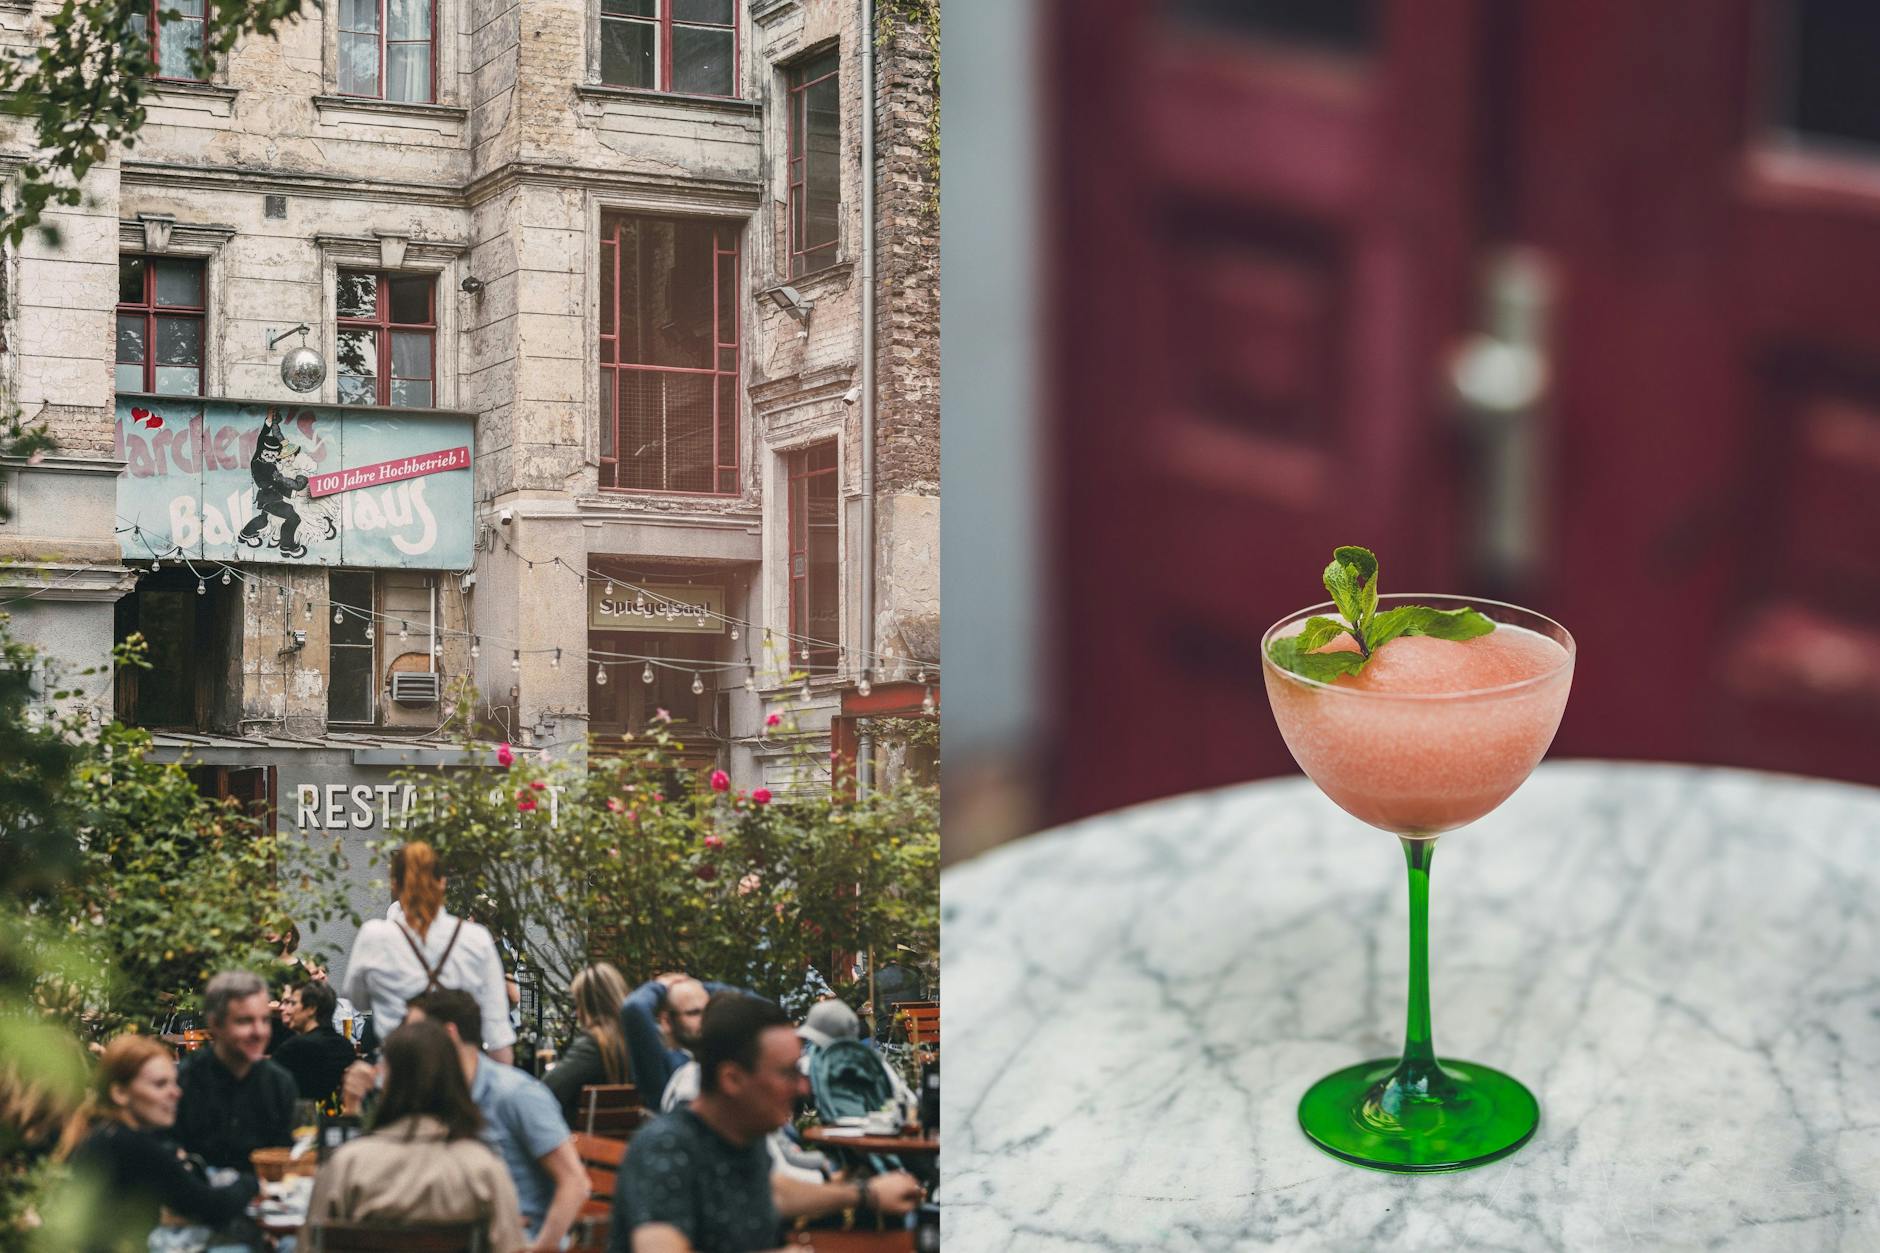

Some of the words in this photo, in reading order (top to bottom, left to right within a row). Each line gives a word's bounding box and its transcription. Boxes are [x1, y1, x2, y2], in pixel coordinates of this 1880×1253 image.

[316, 476, 339, 492] 100
[341, 471, 376, 490] Jahre
[379, 452, 457, 479] Hochbetrieb
[600, 599, 711, 618] Spiegelsaal
[297, 784, 566, 829] RESTAT
